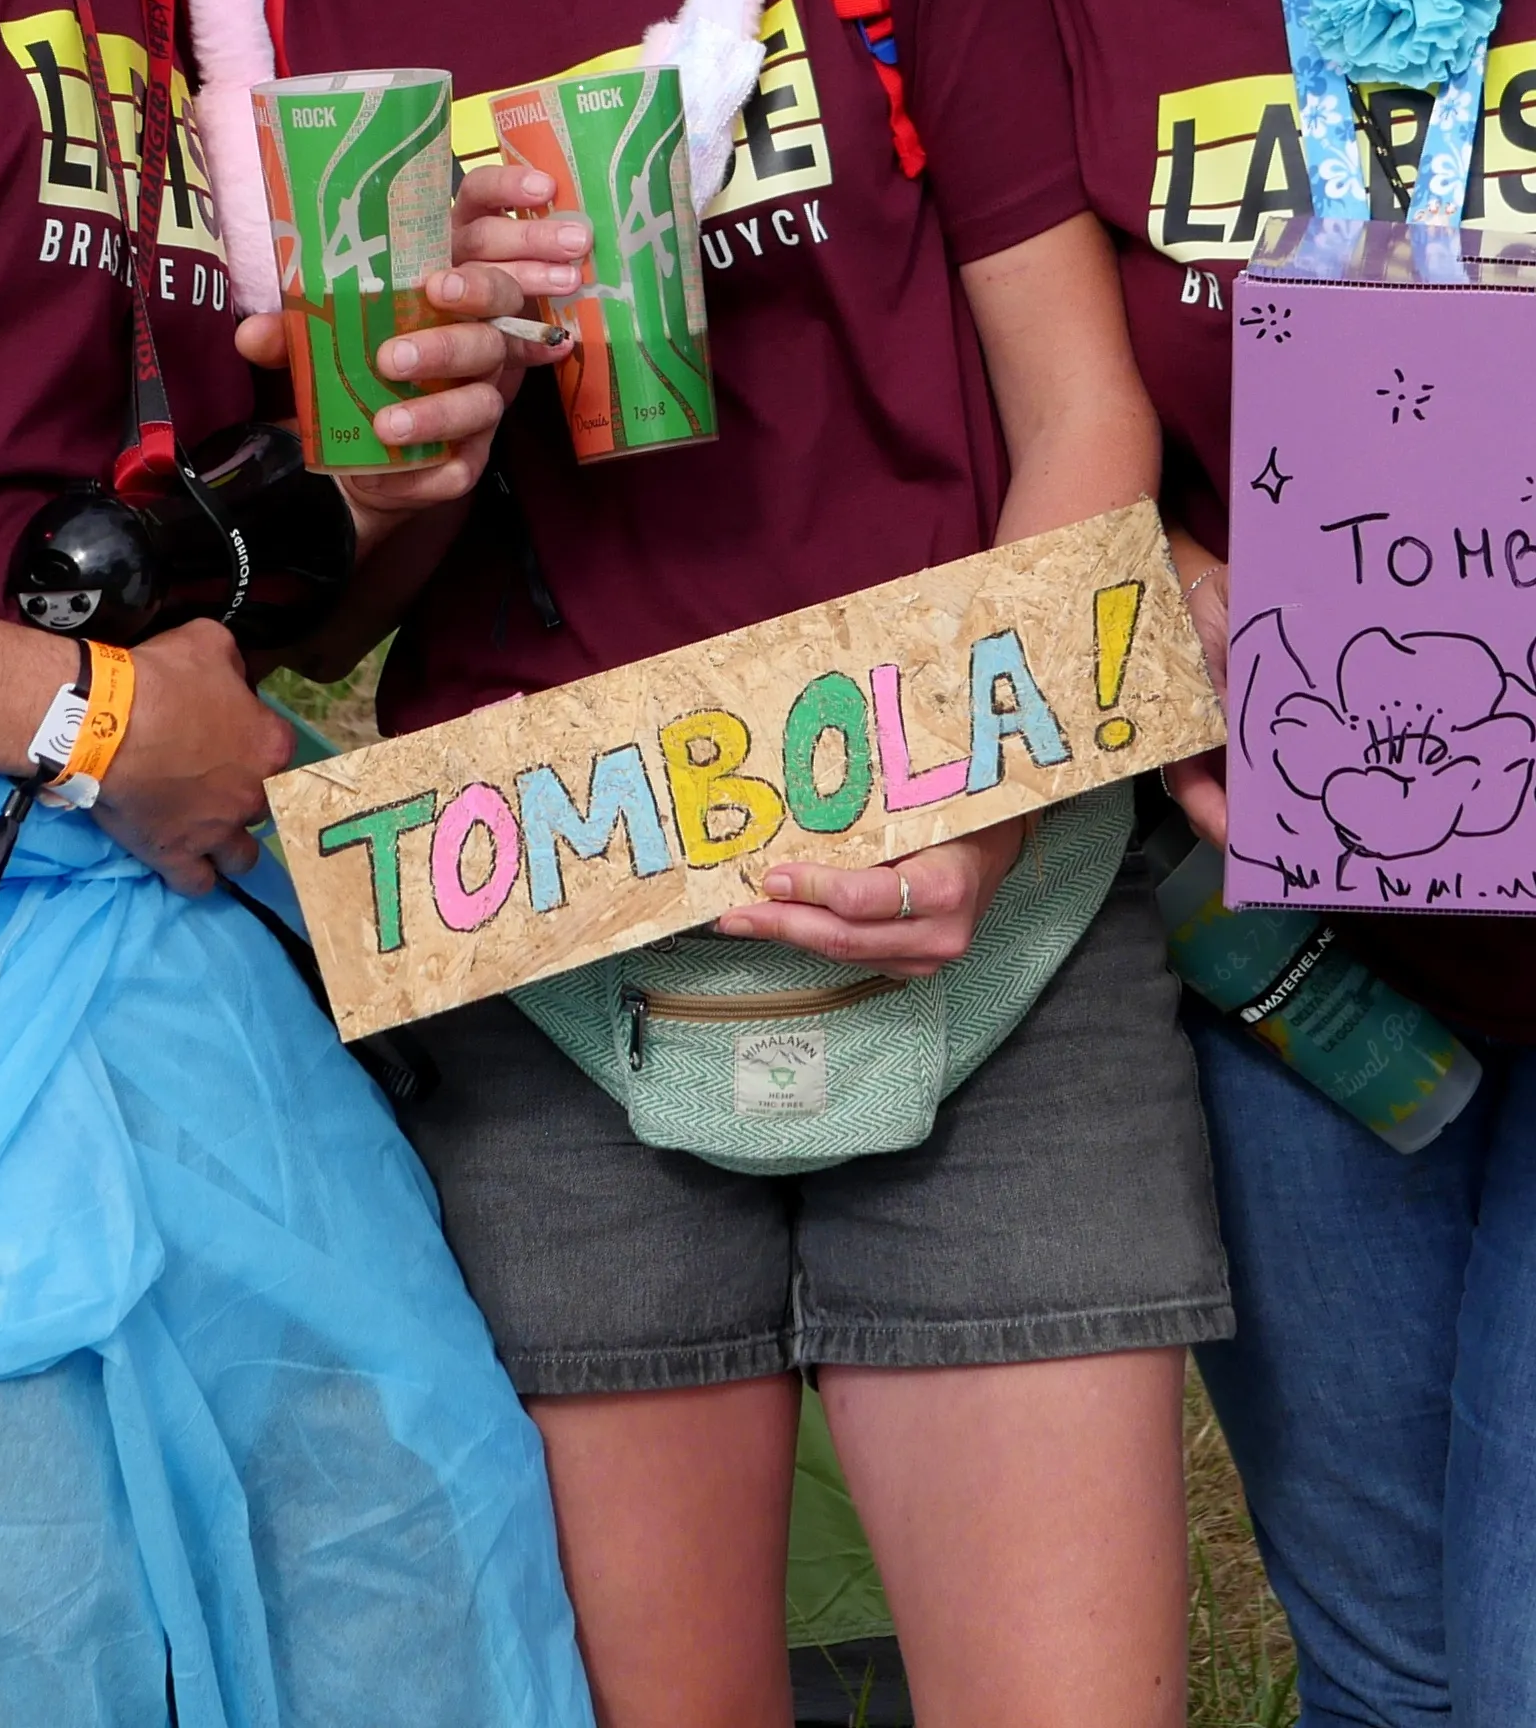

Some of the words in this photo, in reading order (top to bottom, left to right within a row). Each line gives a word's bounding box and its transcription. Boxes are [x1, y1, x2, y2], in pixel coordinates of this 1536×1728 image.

[576, 86, 624, 114] ROCK
[291, 106, 338, 128] ROCK
[1163, 104, 1315, 246] LA
[700, 199, 829, 270] UYCK
[574, 413, 610, 434] Depuis
[633, 401, 667, 422] 1998
[329, 426, 361, 444] 1998
[229, 528, 250, 587] BOUNDS
[742, 1035, 817, 1060] HIMALAYAN
